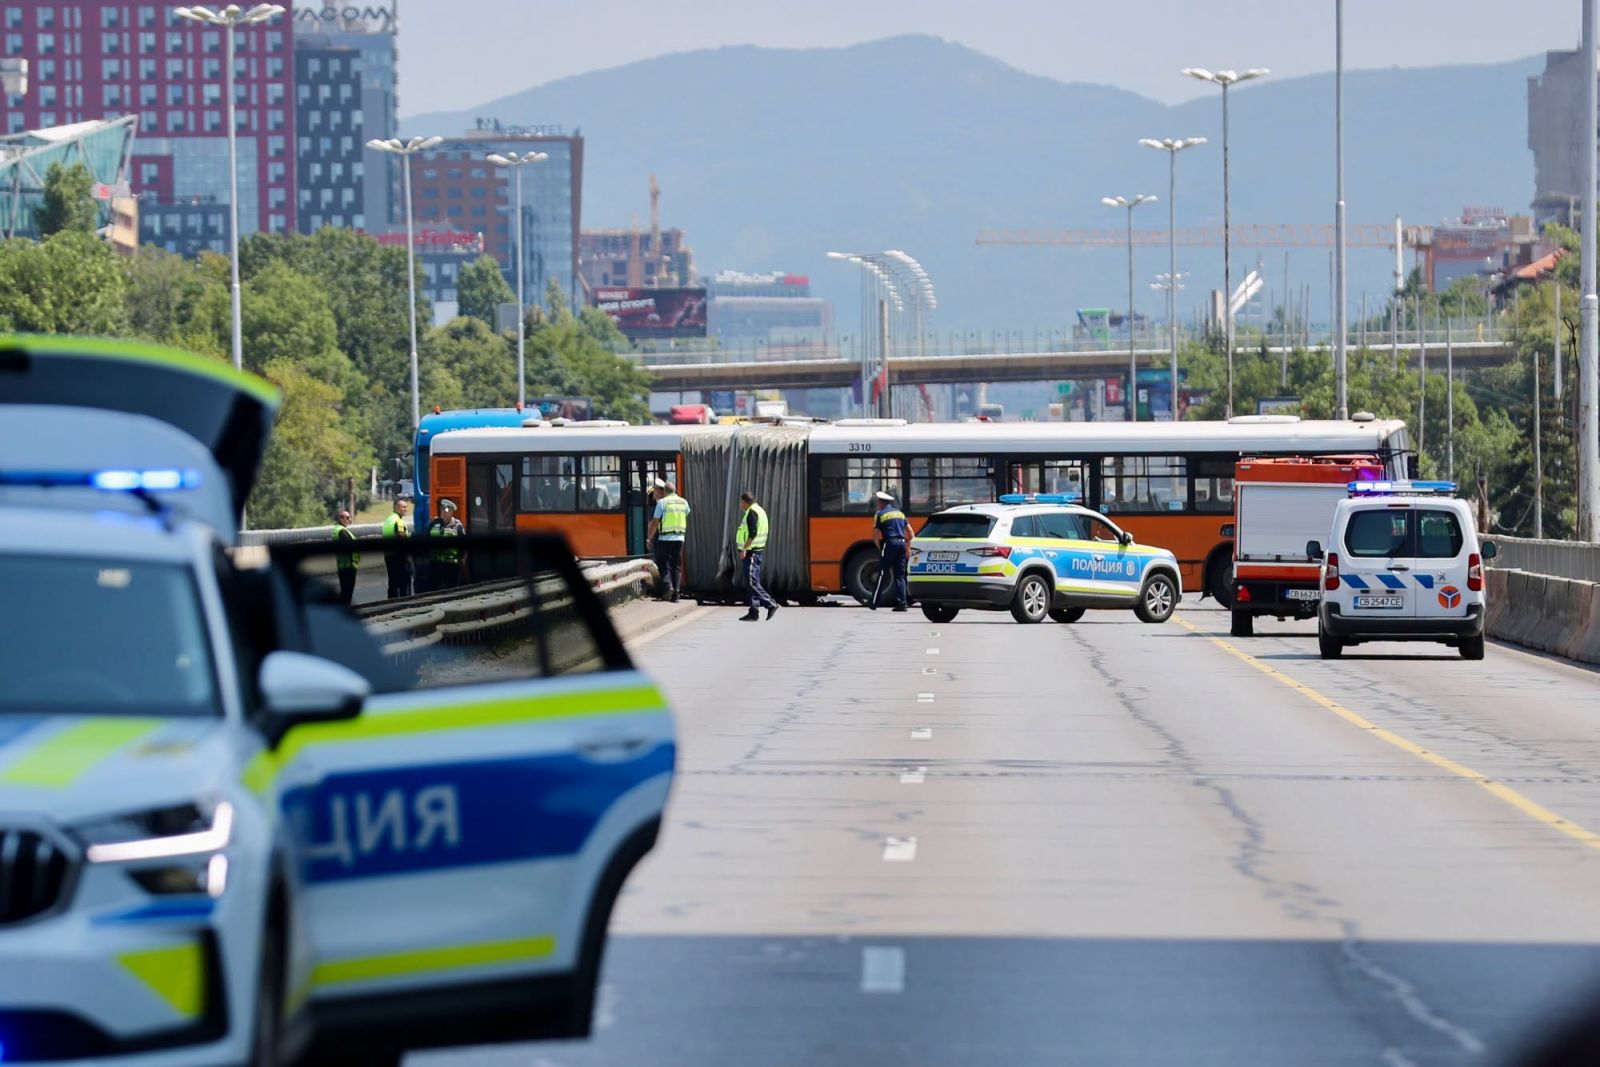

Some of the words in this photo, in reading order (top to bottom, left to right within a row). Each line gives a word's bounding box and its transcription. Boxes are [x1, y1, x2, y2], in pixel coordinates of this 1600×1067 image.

[849, 442, 871, 451] 3310
[926, 563, 956, 572] POLICE
[1072, 558, 1122, 574] ПОЛИЦИЯ
[1359, 598, 1370, 606] CB
[1371, 598, 1389, 606] 2547
[1390, 598, 1401, 606] CE
